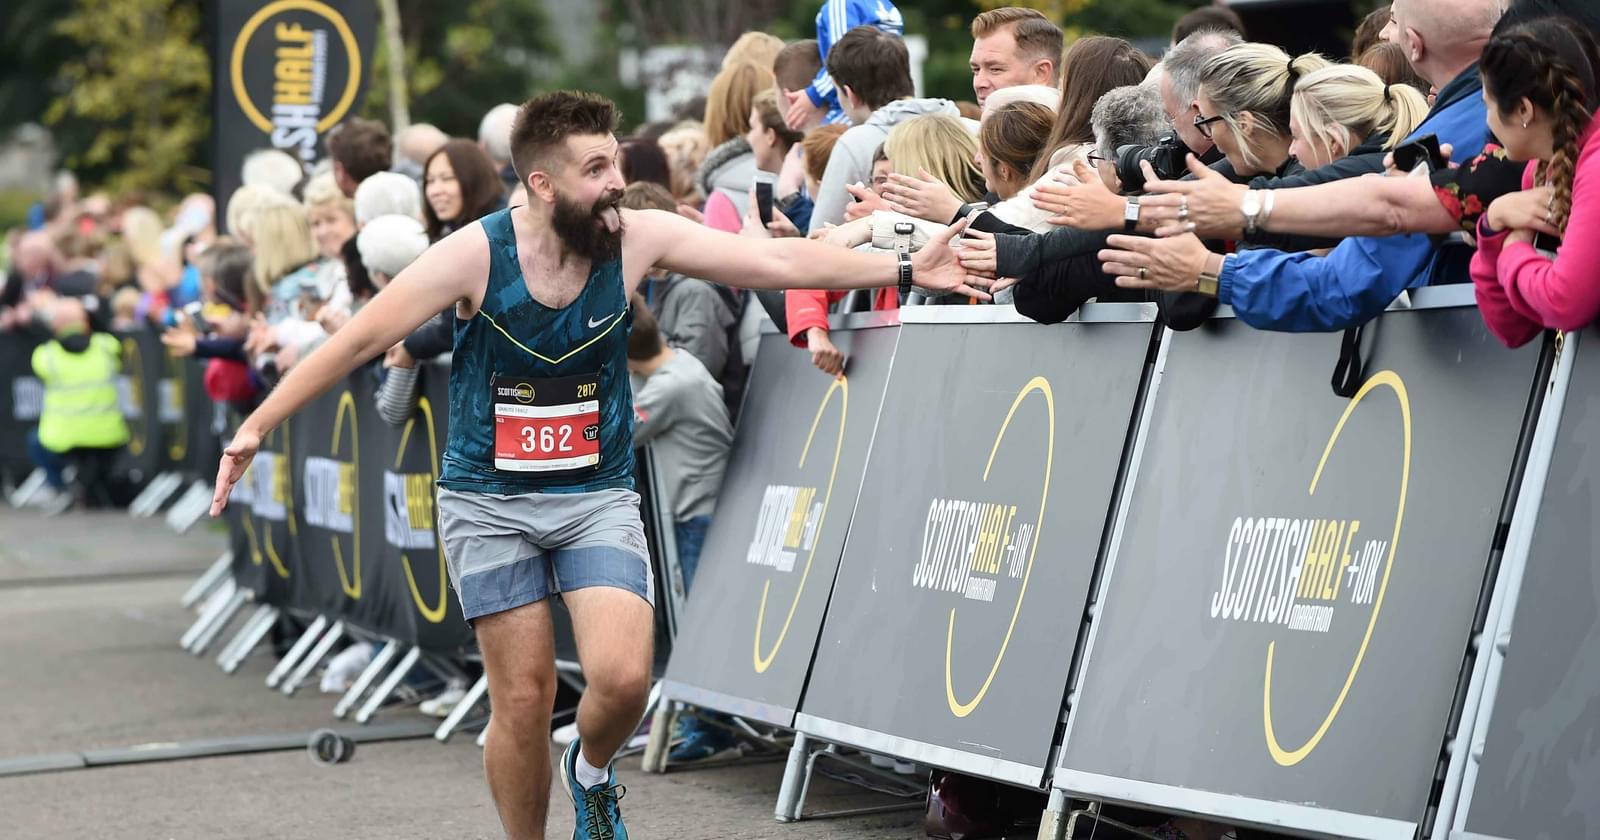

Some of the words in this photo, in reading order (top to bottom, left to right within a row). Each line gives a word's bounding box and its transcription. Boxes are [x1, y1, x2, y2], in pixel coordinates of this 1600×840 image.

[273, 21, 315, 104] HALF
[577, 383, 597, 398] 2017
[521, 424, 573, 453] 362
[912, 498, 986, 594] SCOTTISH
[971, 503, 1017, 575] HALF
[1211, 517, 1314, 624] SCOTTISH
[1296, 519, 1360, 600] HALF
[1288, 604, 1334, 632] MARATHON
